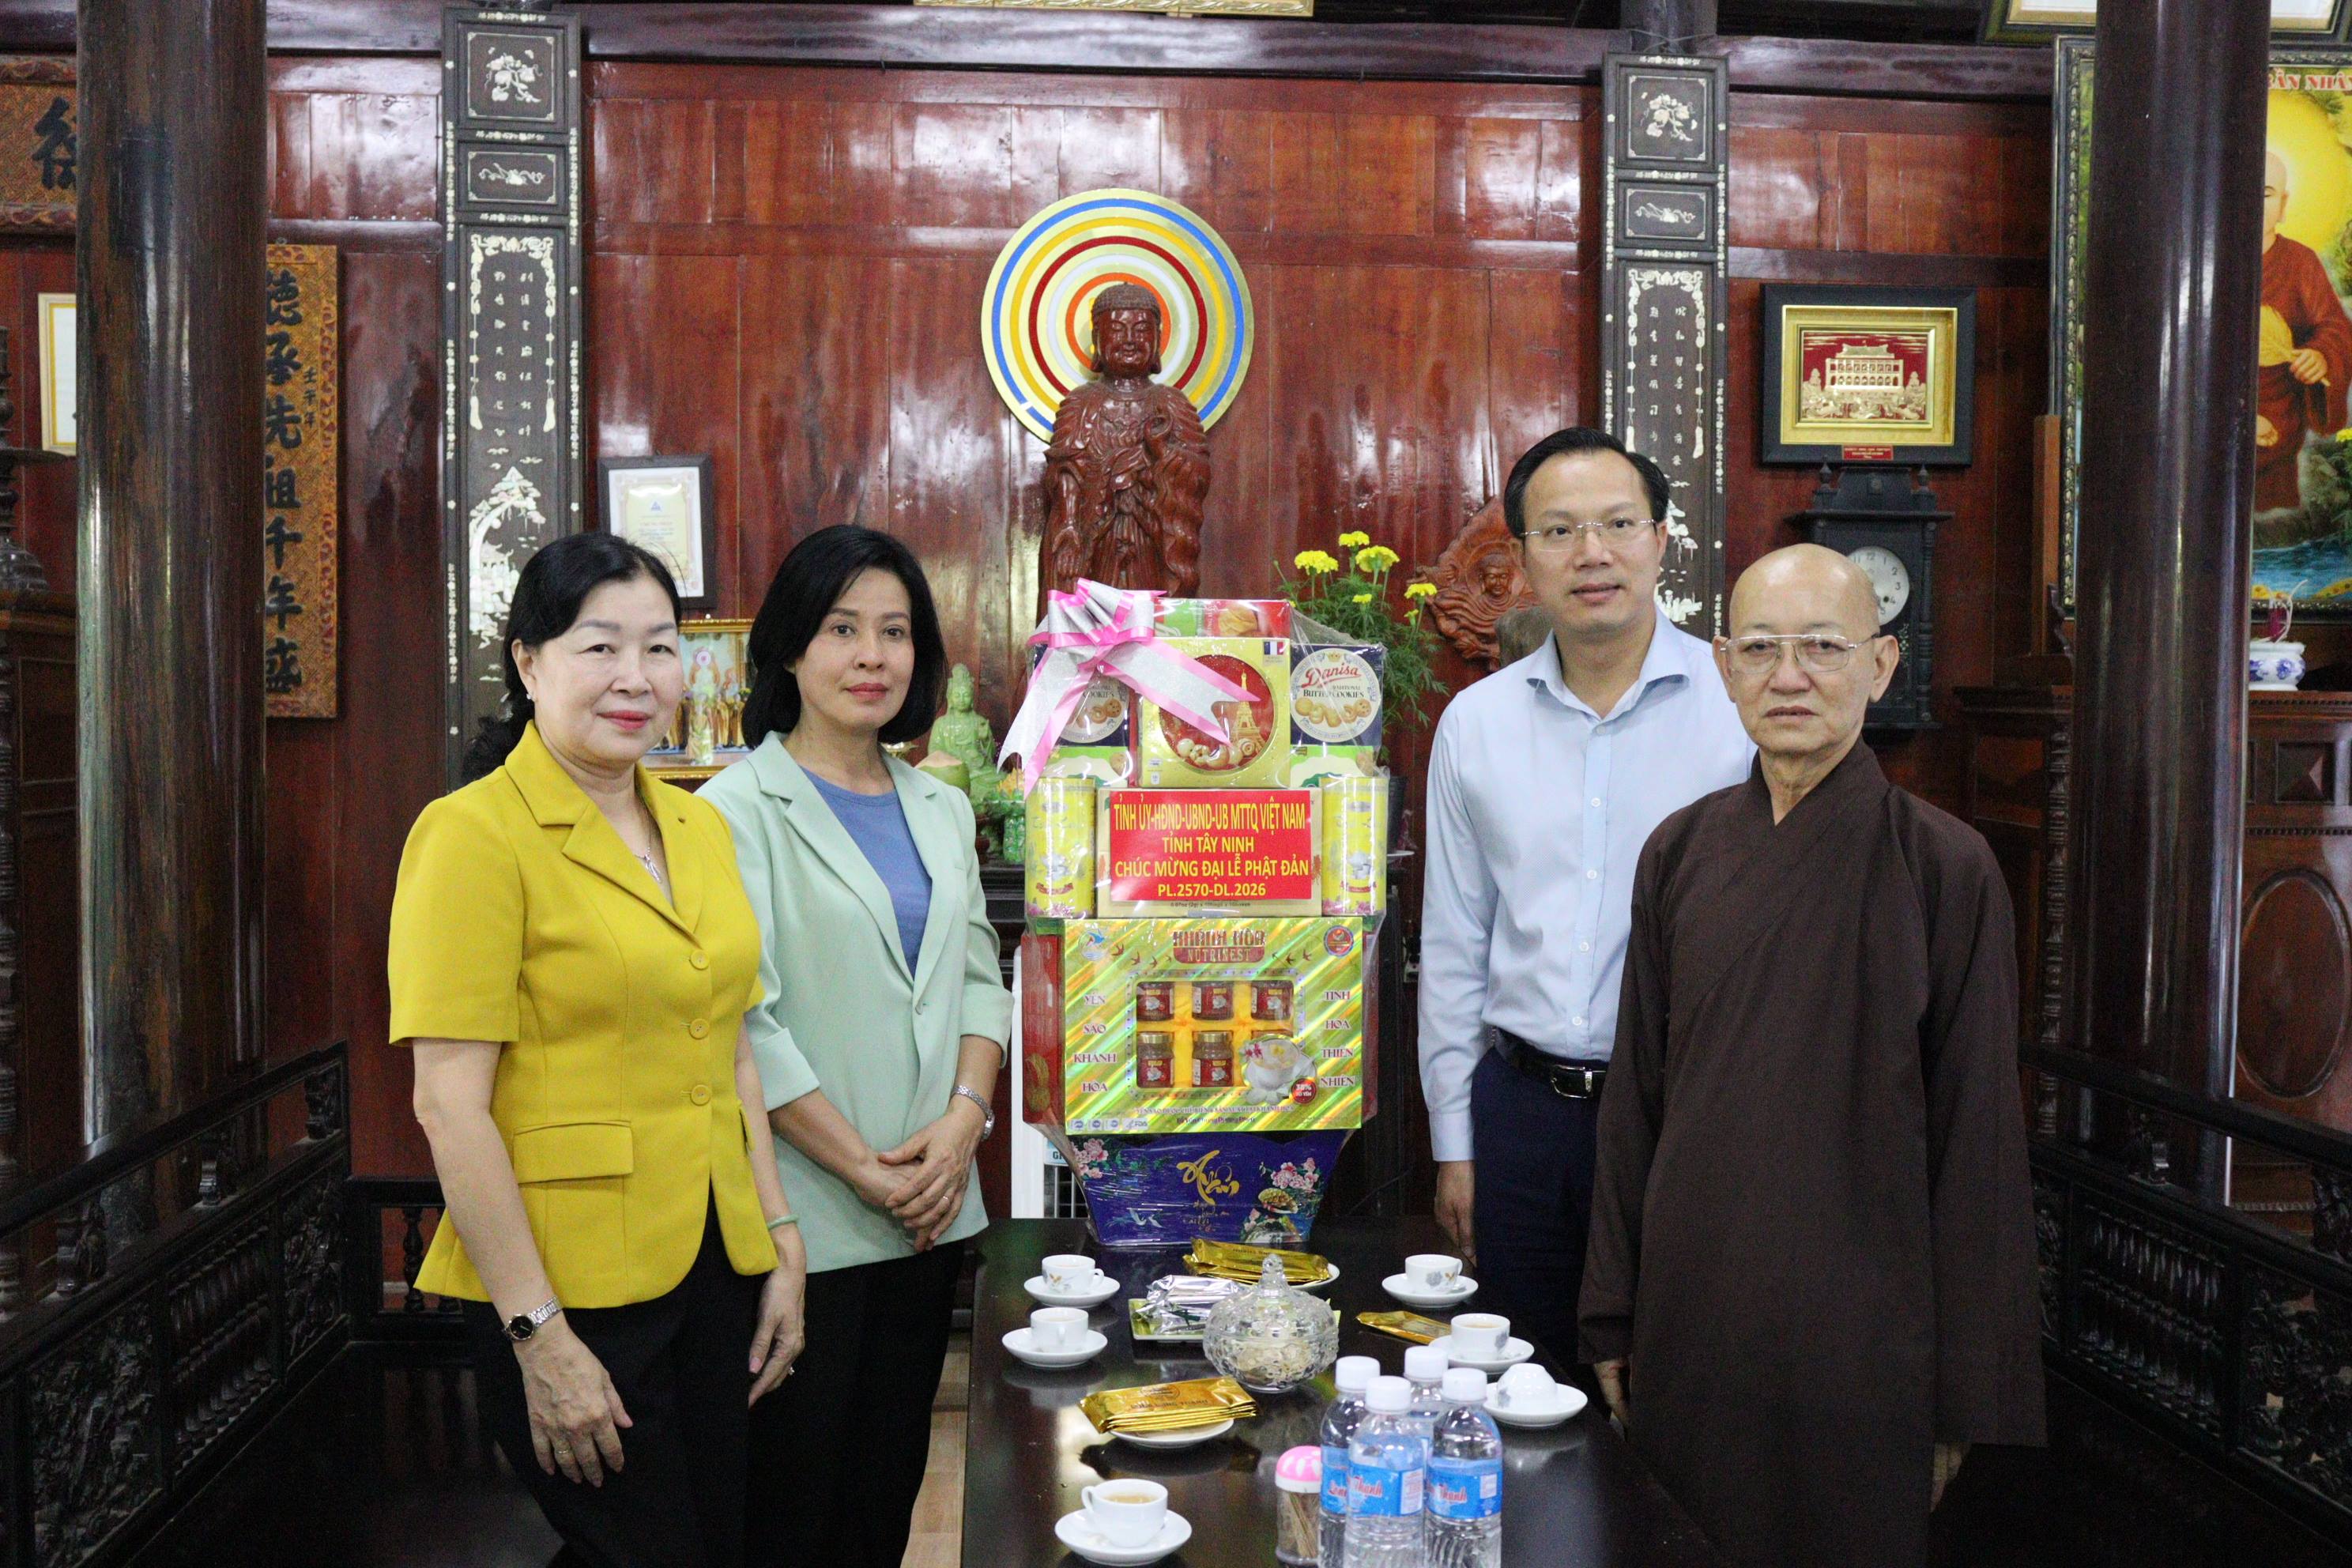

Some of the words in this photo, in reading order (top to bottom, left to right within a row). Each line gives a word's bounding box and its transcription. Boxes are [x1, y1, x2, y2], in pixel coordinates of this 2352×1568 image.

[1302, 662, 1361, 689] Danisa
[1333, 690, 1365, 699] COOKIES
[1114, 793, 1136, 831] TỈNH
[1231, 803, 1259, 833] MTTQ
[1260, 797, 1280, 835] VIỆT
[1282, 803, 1306, 830] NAM
[1162, 831, 1193, 853] TỈNH
[1196, 832, 1219, 853] TÂY
[1222, 836, 1254, 854] NINH
[1114, 857, 1152, 877] CHÚC
[1155, 857, 1198, 877] MỪNG
[1201, 860, 1224, 880] ĐẠI
[1227, 854, 1242, 876] LỄ
[1245, 855, 1278, 880] PHẬT
[1280, 854, 1309, 876] ĐẢN
[1157, 883, 1266, 897] PL.2570-DL.2026
[1187, 948, 1251, 962] NUTRINEST
